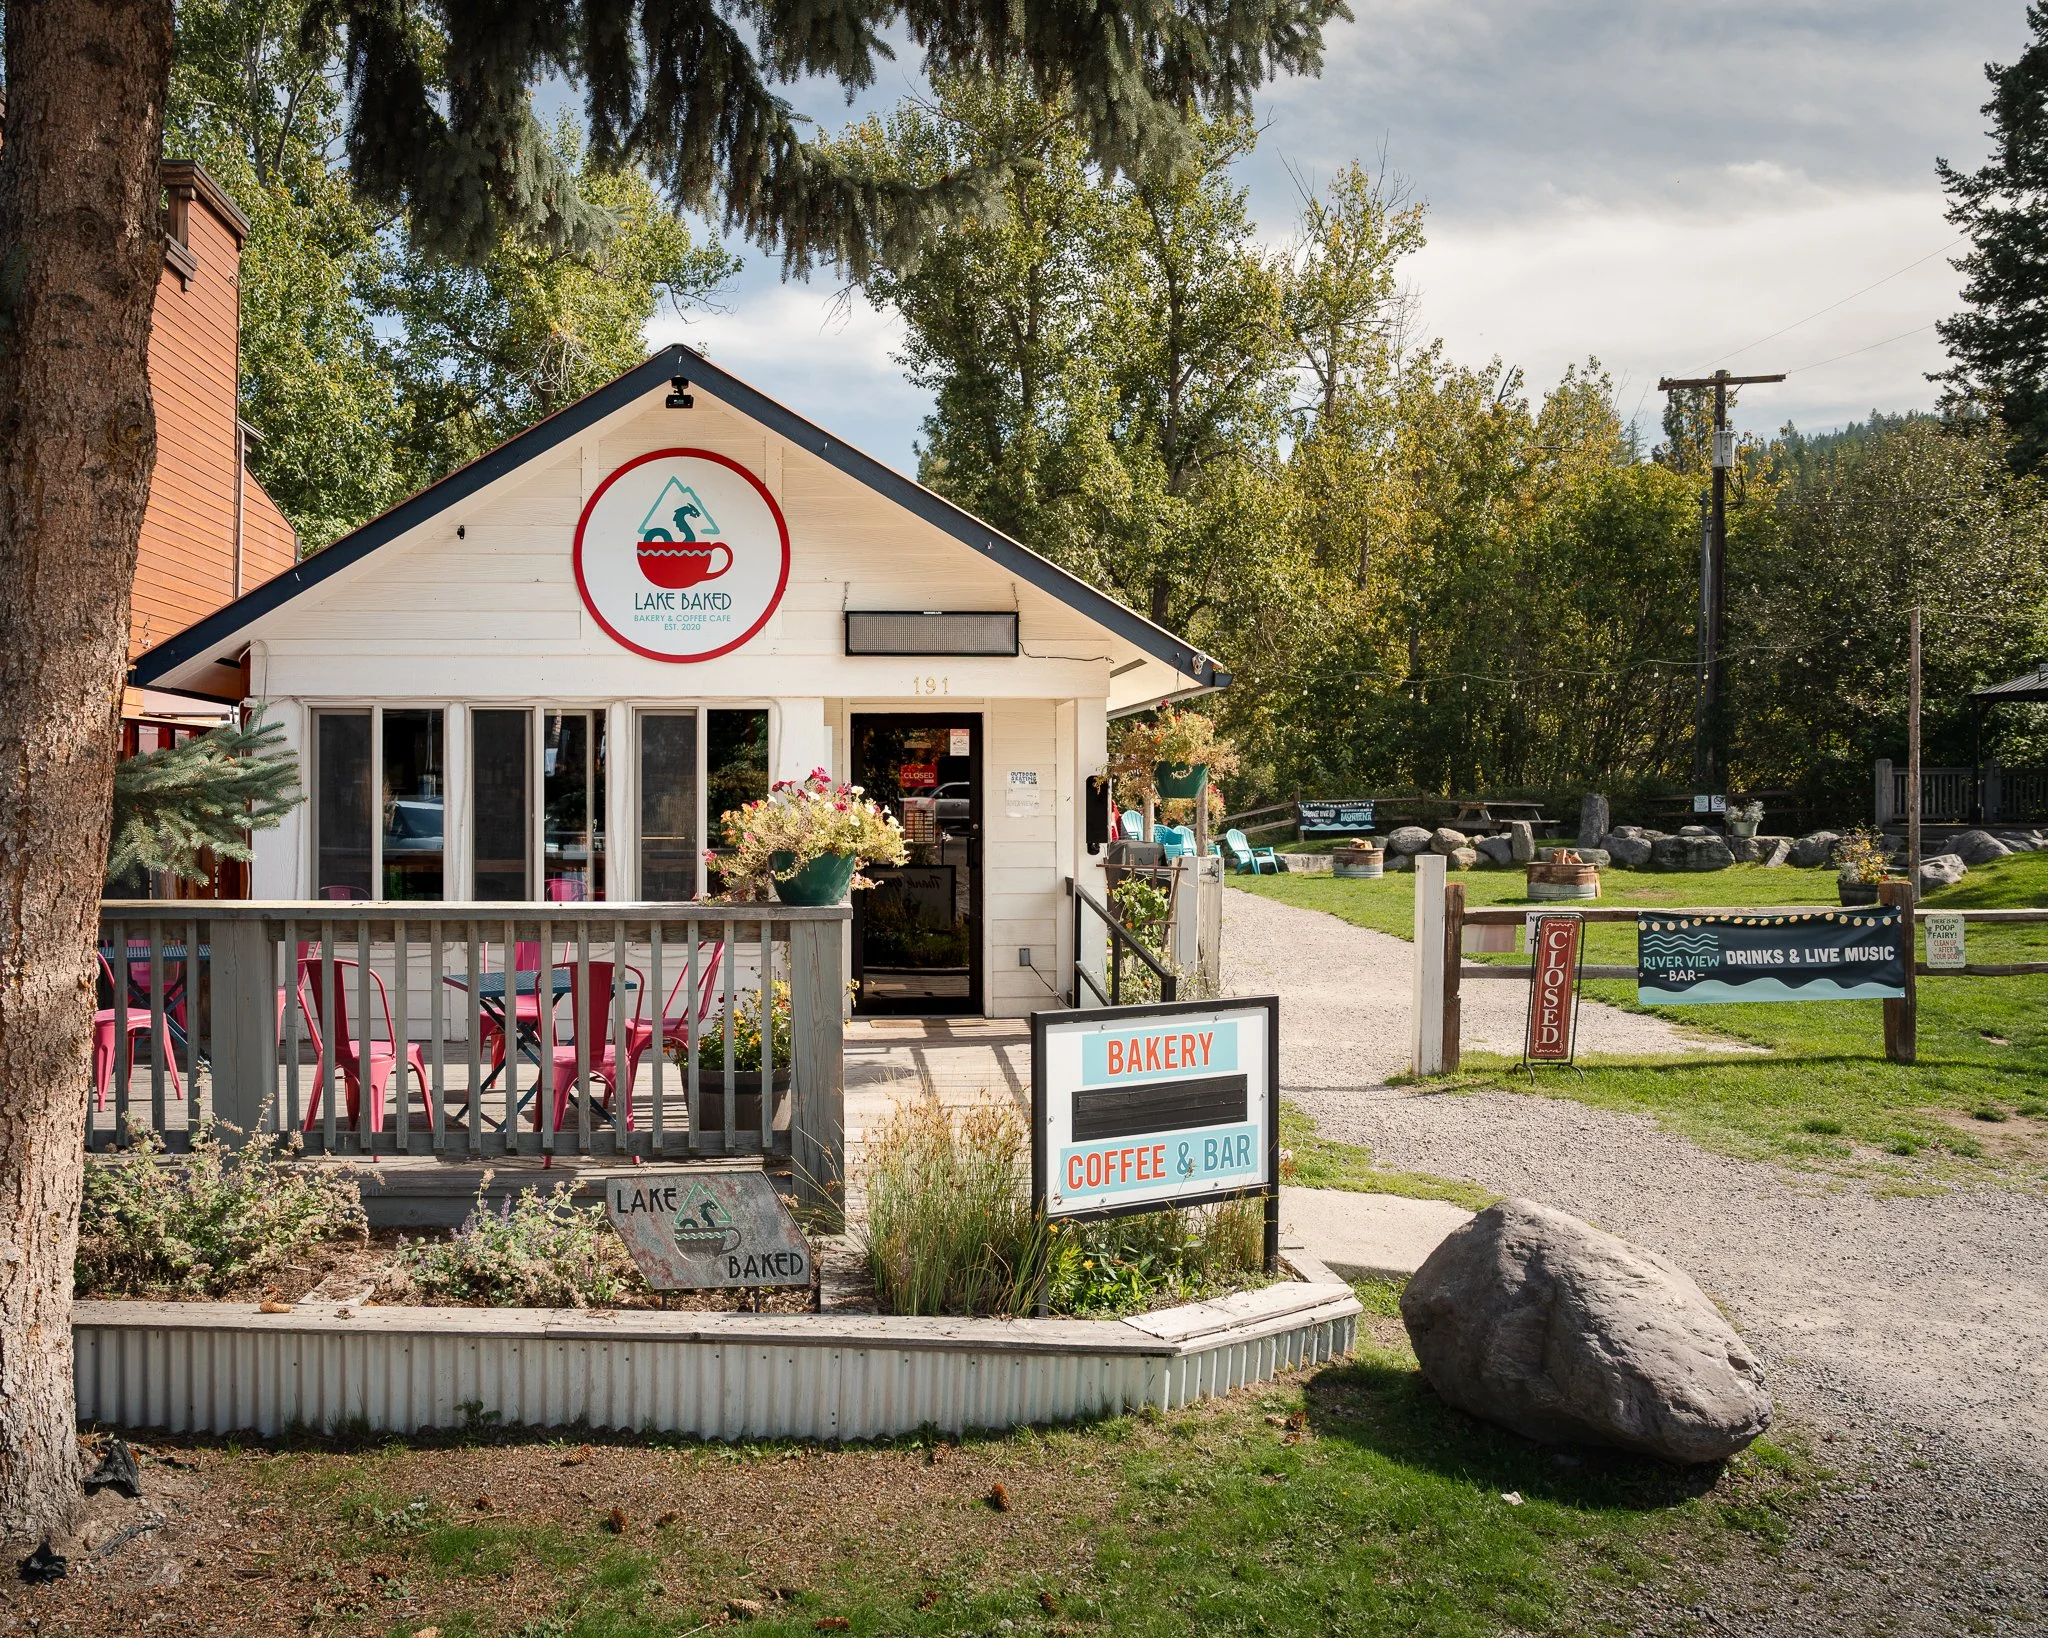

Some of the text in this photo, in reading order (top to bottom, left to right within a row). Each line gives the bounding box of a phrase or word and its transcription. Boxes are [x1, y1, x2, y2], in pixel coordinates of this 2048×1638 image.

[635, 592, 732, 610] LAKE BAKED
[634, 614, 731, 622] BAKERY & COFFEE CAFE
[664, 623, 701, 631] EST. 2020
[913, 676, 950, 695] 191
[1643, 955, 1720, 970] RIVER VIEW
[1726, 945, 1895, 965] DRINKS & LIVE MUSIC
[1540, 931, 1568, 1044] CLOSED
[1107, 1032, 1214, 1075] BAKERY
[1067, 1134, 1251, 1190] COFFEE & BAR
[617, 1187, 677, 1214] LAKE
[728, 1252, 804, 1279] BAKED
